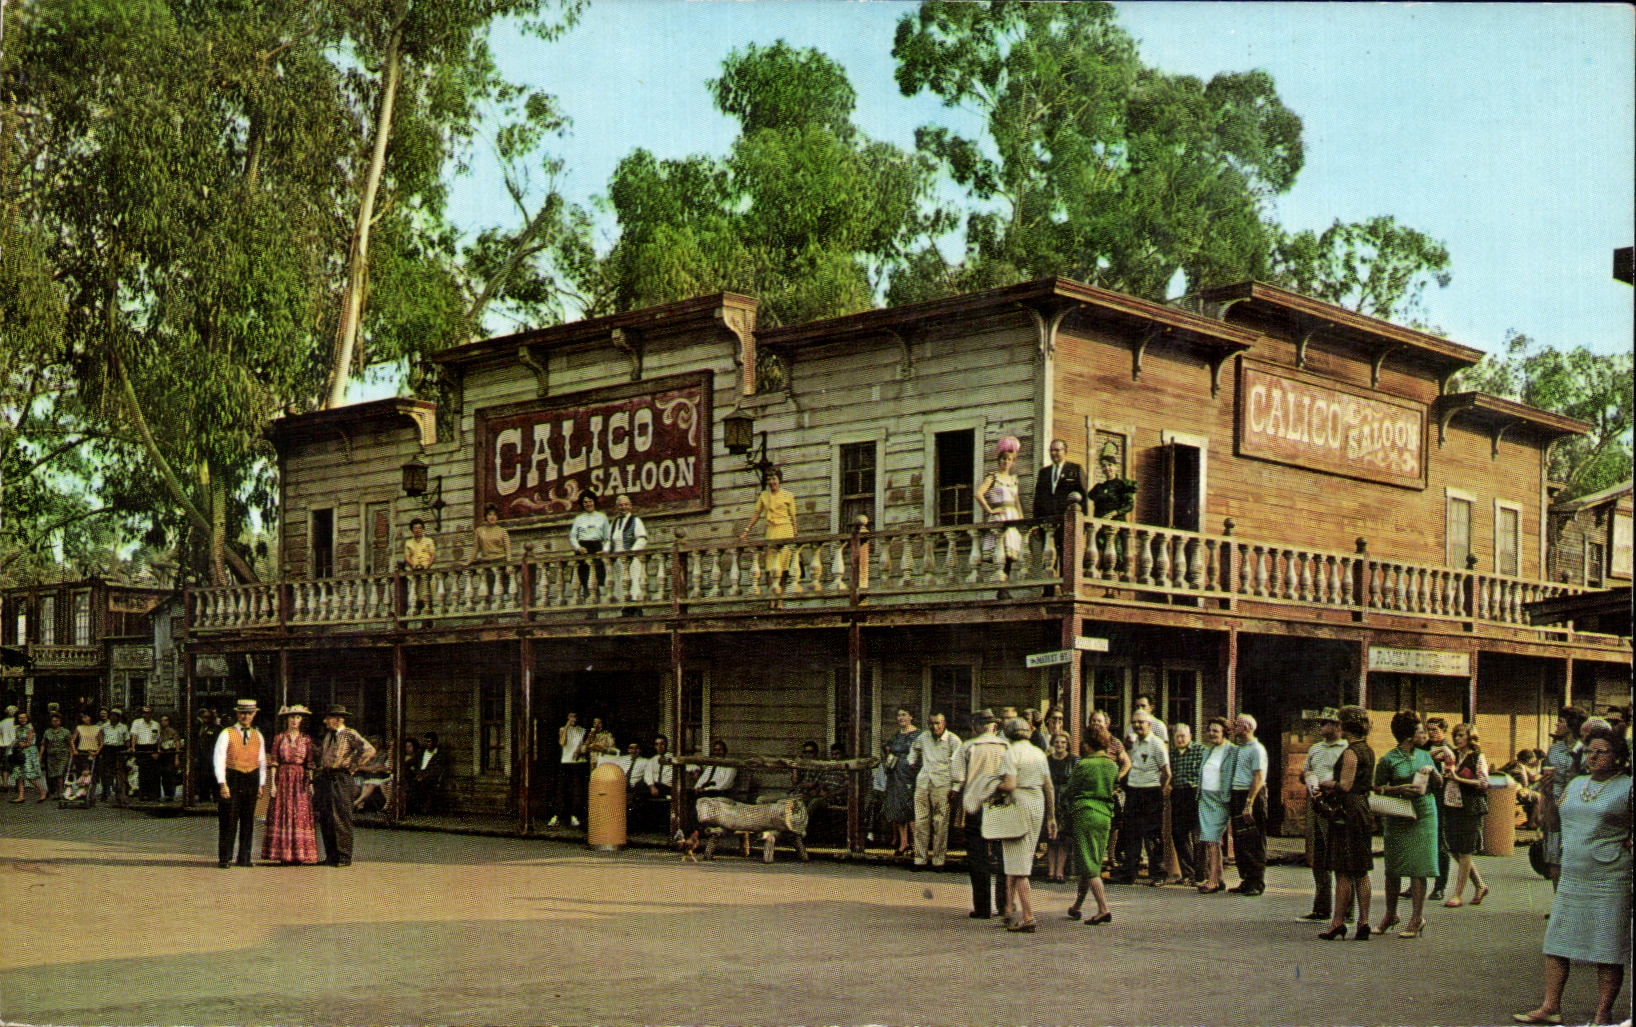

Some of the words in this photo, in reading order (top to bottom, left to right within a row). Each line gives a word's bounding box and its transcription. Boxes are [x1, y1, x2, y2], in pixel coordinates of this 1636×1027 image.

[1250, 384, 1342, 449] CALICO
[1348, 418, 1422, 460] SALOON
[495, 407, 653, 496] CALICO
[590, 455, 697, 496] SALOON
